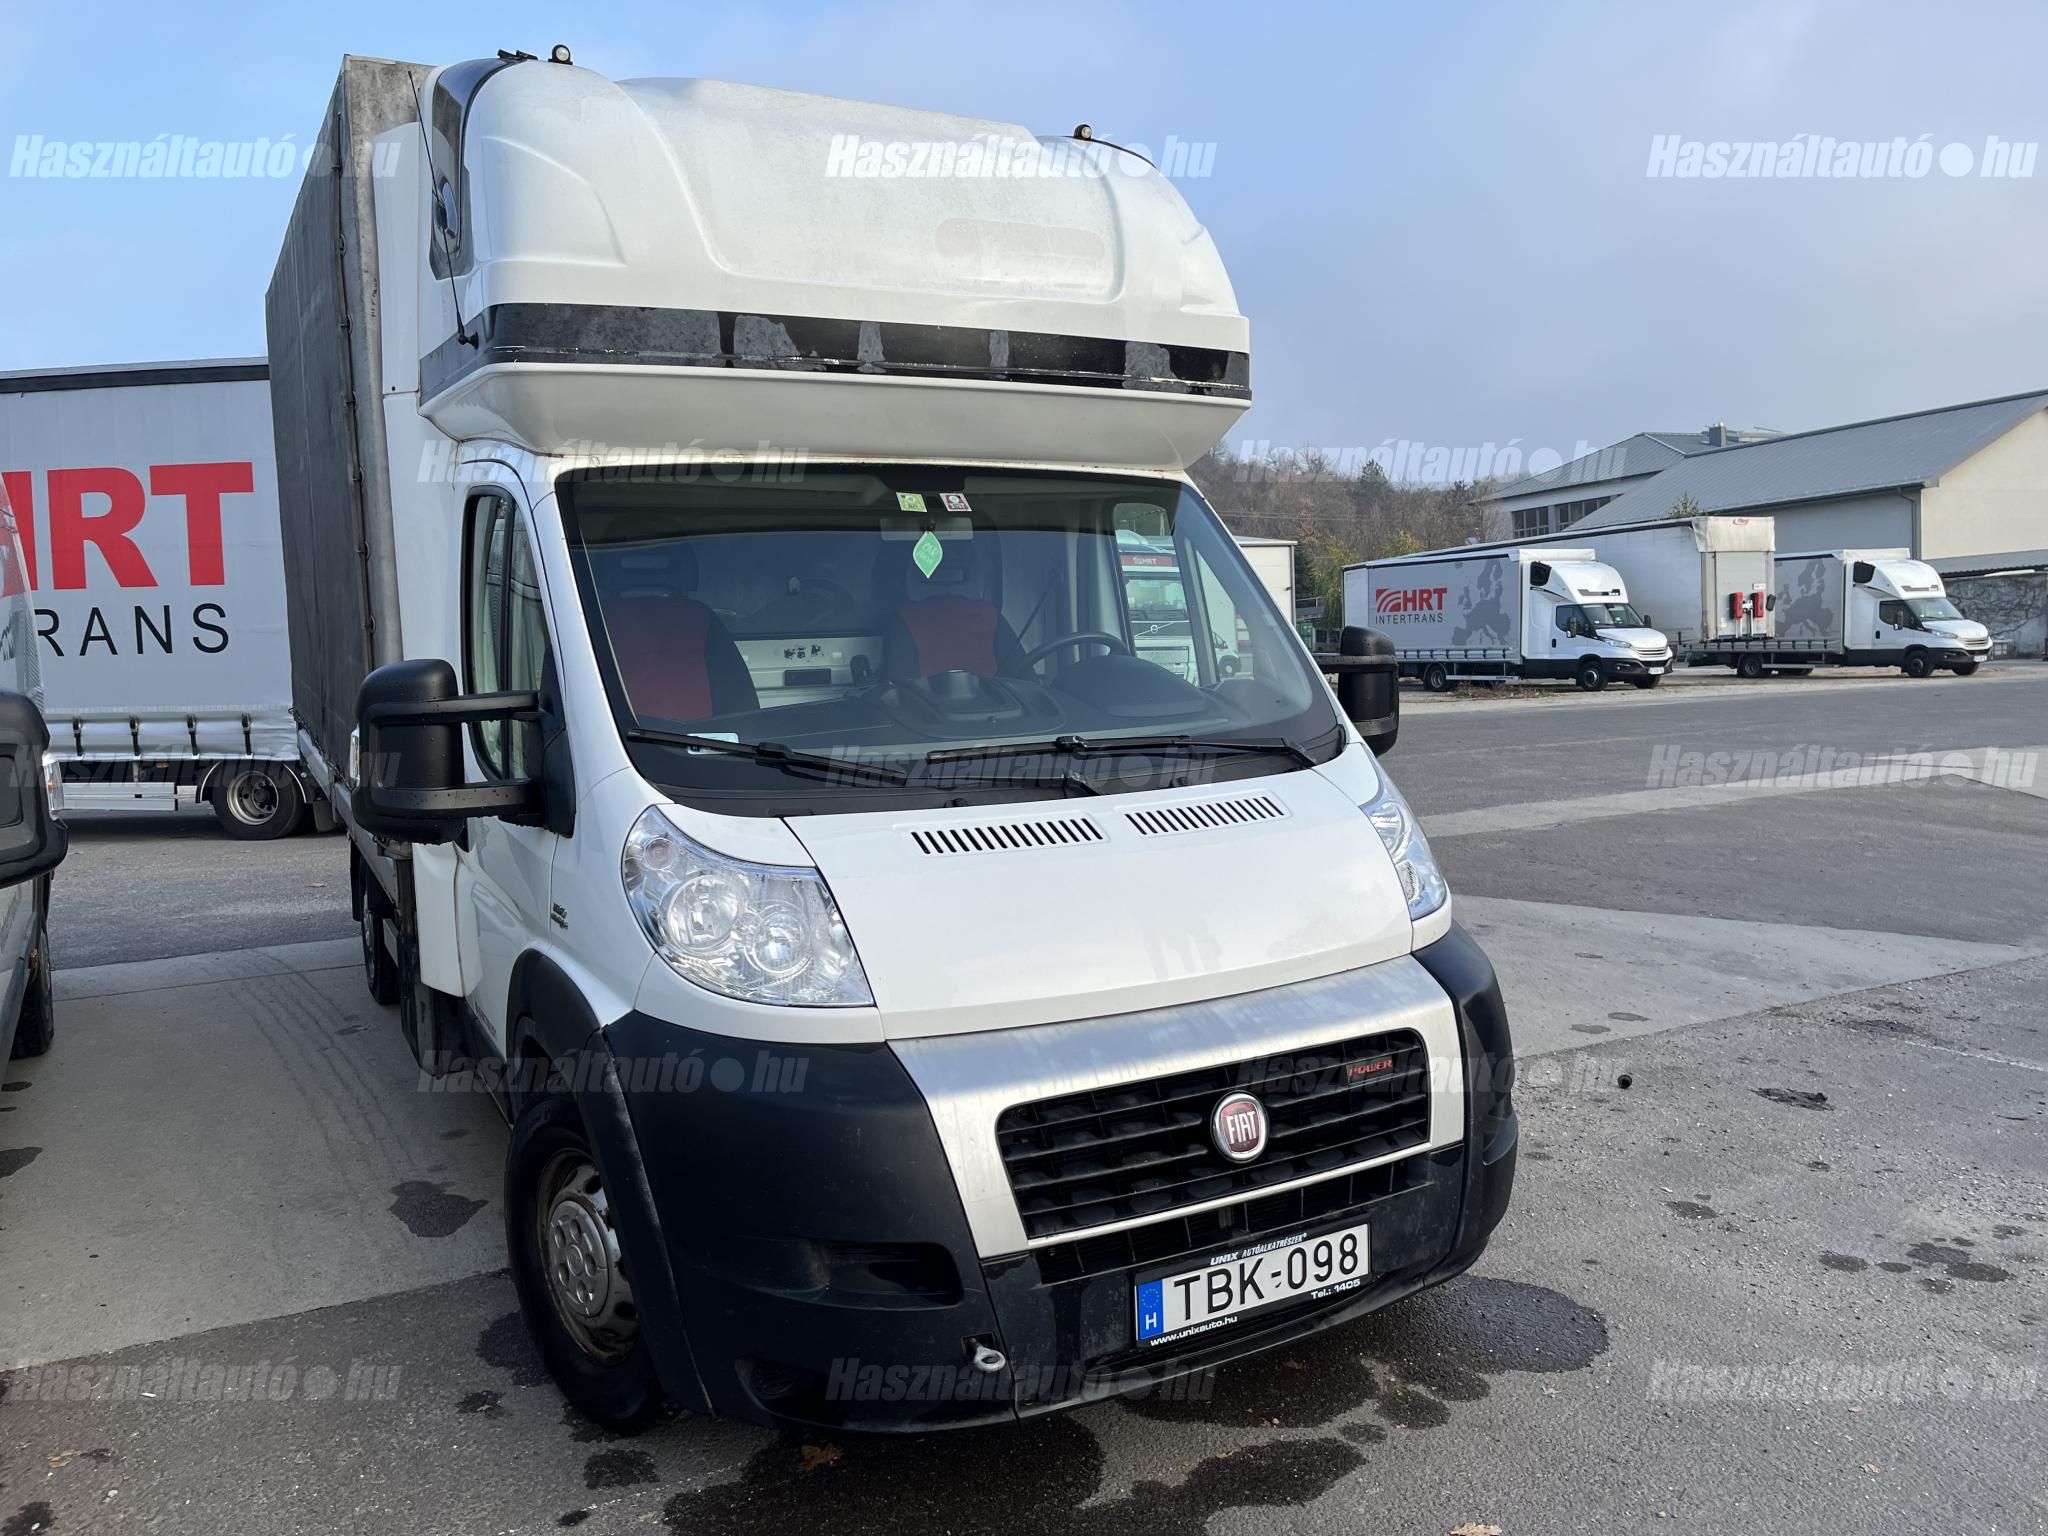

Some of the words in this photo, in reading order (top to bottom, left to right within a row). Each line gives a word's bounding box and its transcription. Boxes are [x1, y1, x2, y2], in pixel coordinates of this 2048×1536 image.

[1402, 588, 1448, 612] HRT
[1375, 613, 1443, 625] INTERTRANS
[1348, 1058, 1393, 1077] POWER
[1226, 1110, 1258, 1145] FIAT
[1210, 1252, 1239, 1266] UNIX
[1173, 1232, 1359, 1321] TBK-098
[1310, 1288, 1332, 1300] Tel.:
[1333, 1278, 1361, 1293] 1405
[1145, 1312, 1157, 1331] H
[1150, 1315, 1238, 1347] www.unixauto.hu
